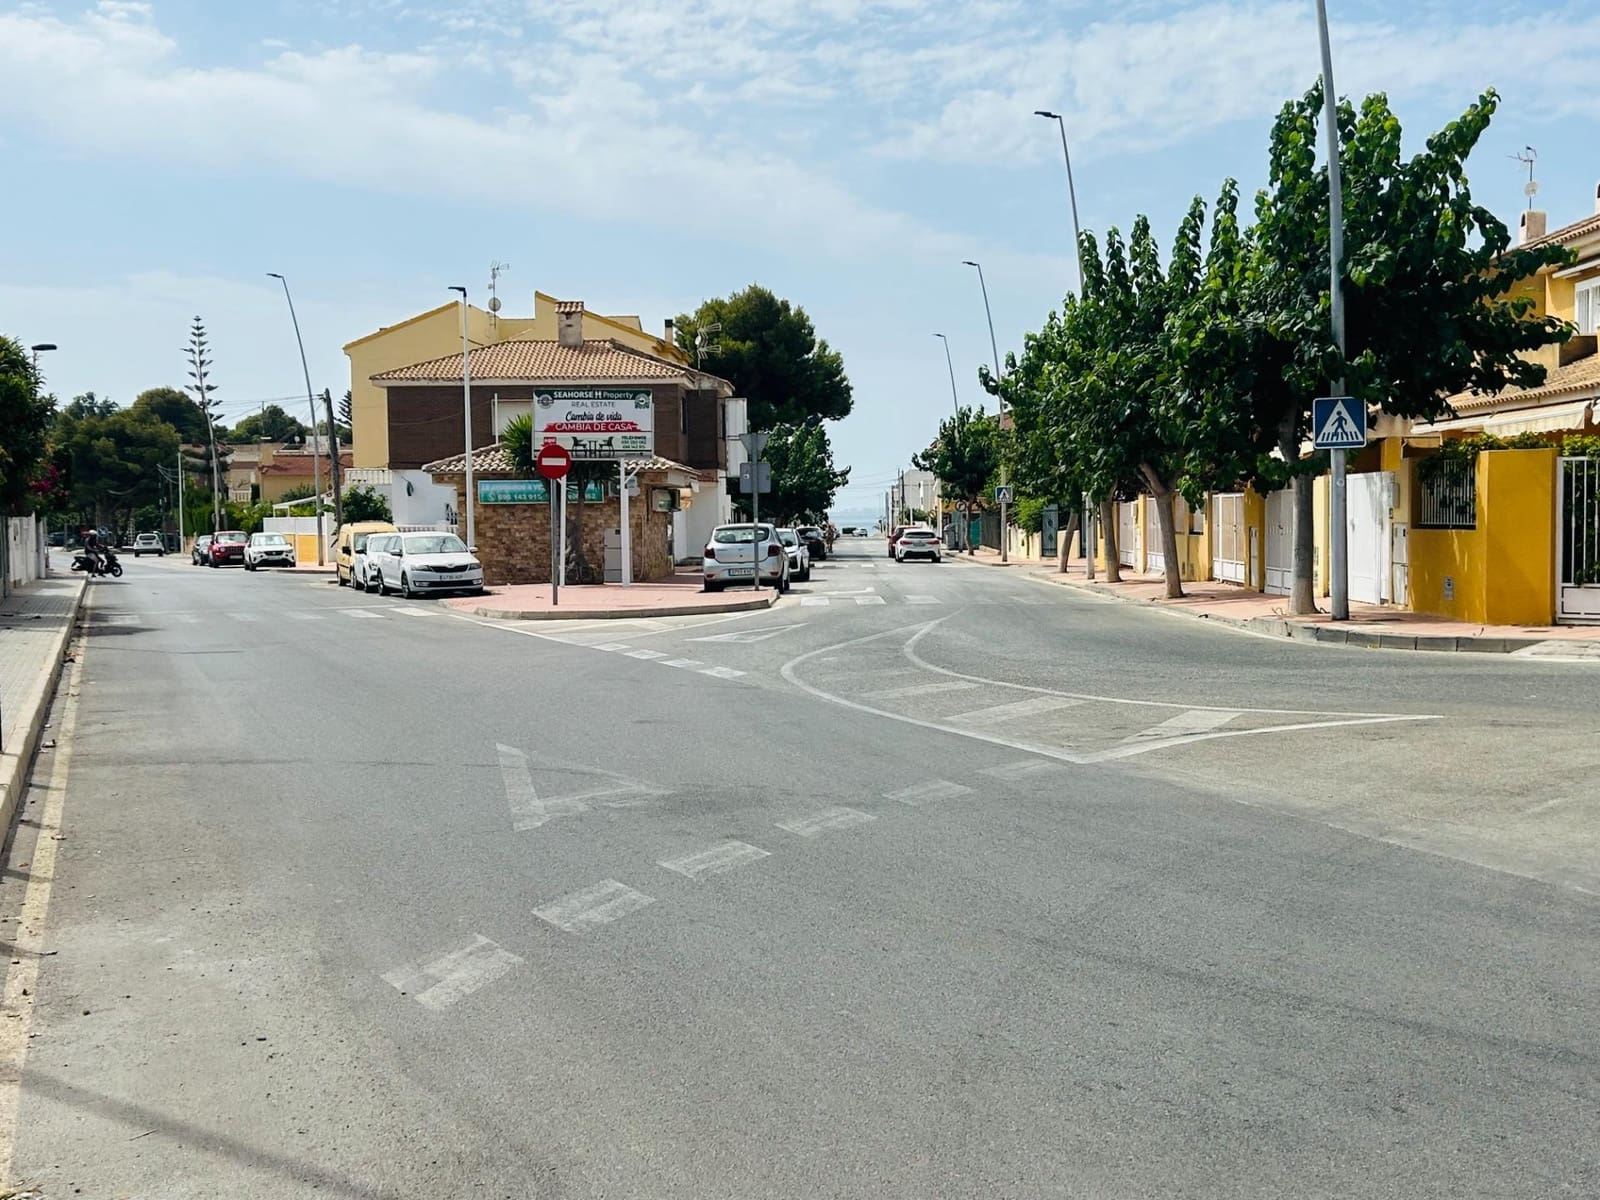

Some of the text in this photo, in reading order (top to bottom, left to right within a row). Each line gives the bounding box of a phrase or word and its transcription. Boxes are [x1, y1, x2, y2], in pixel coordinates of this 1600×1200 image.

[553, 391, 593, 399] SEAHORSE
[603, 391, 634, 400] Property
[565, 411, 623, 422] Cambia de vida
[554, 423, 633, 431] CAMBIA DE CASA
